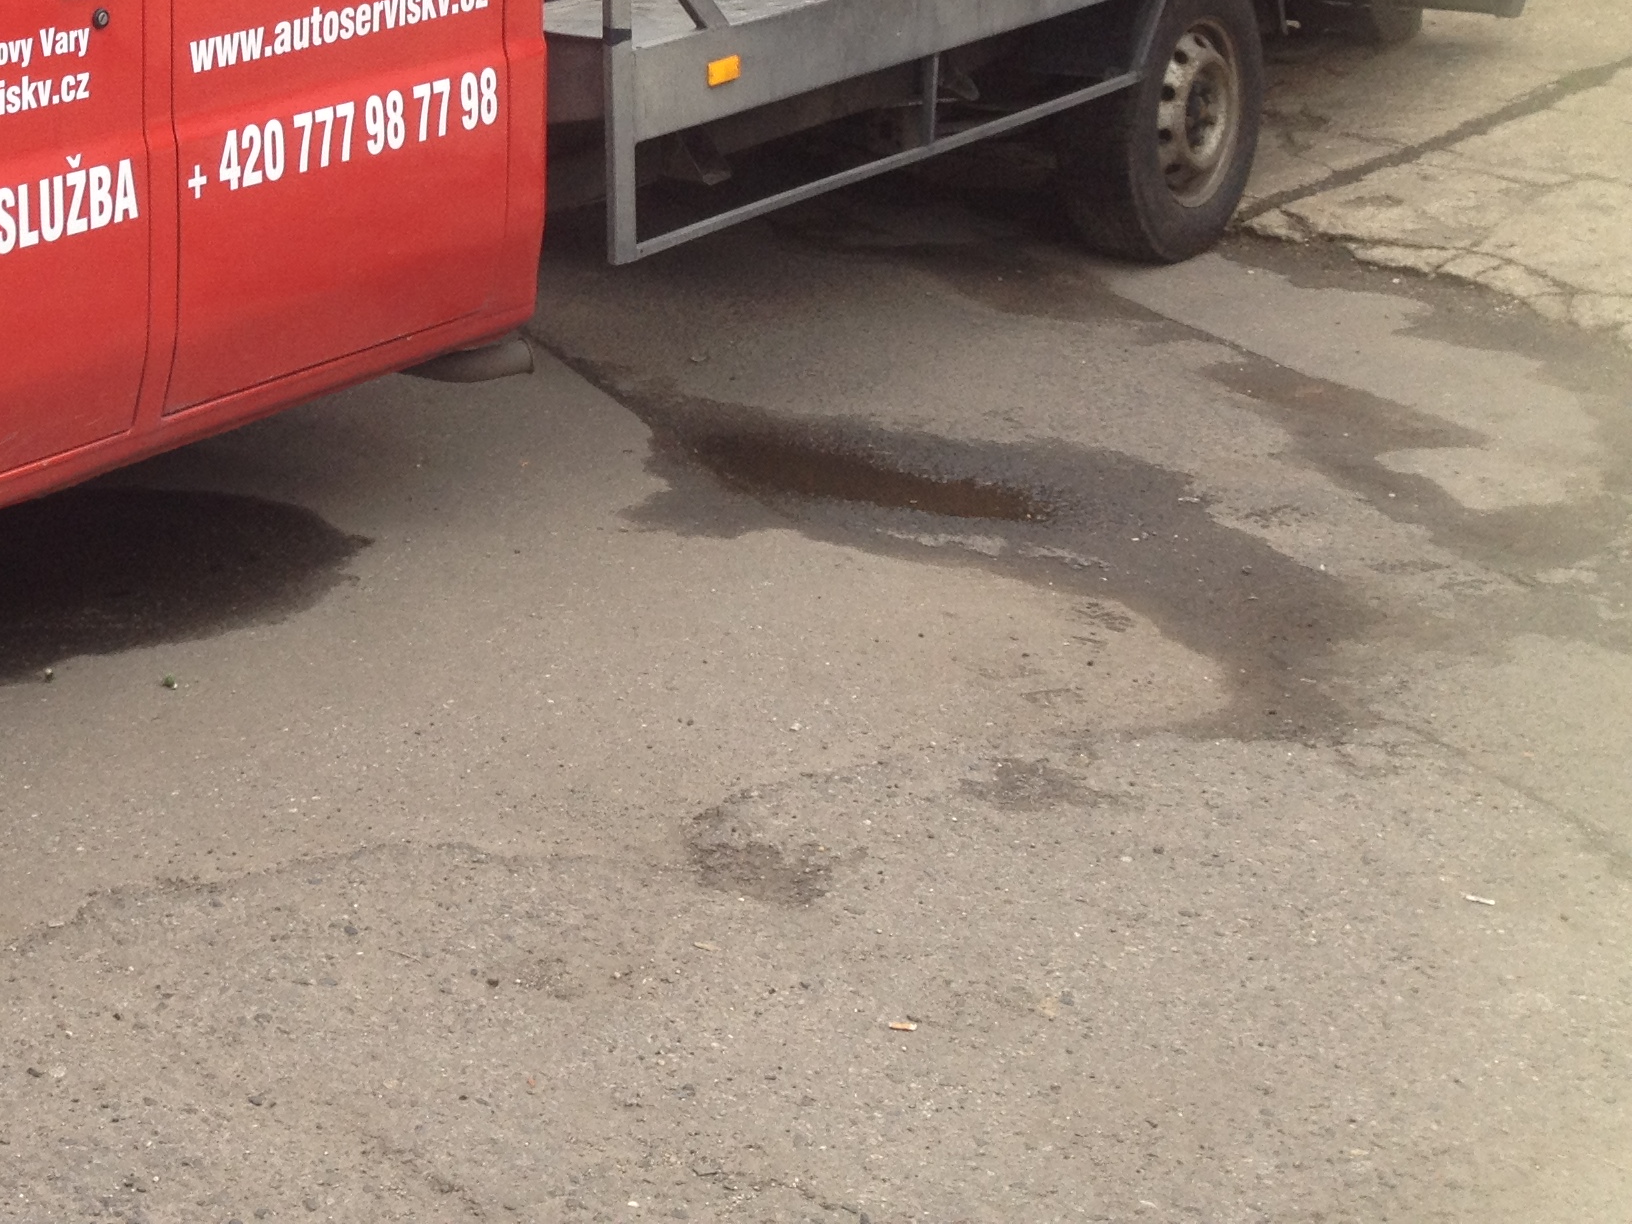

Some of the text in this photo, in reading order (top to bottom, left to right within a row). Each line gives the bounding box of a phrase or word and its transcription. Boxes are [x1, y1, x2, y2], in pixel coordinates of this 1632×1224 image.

[39, 26, 89, 59] Vary
[188, 67, 497, 199] + 420 777 98 77 98
